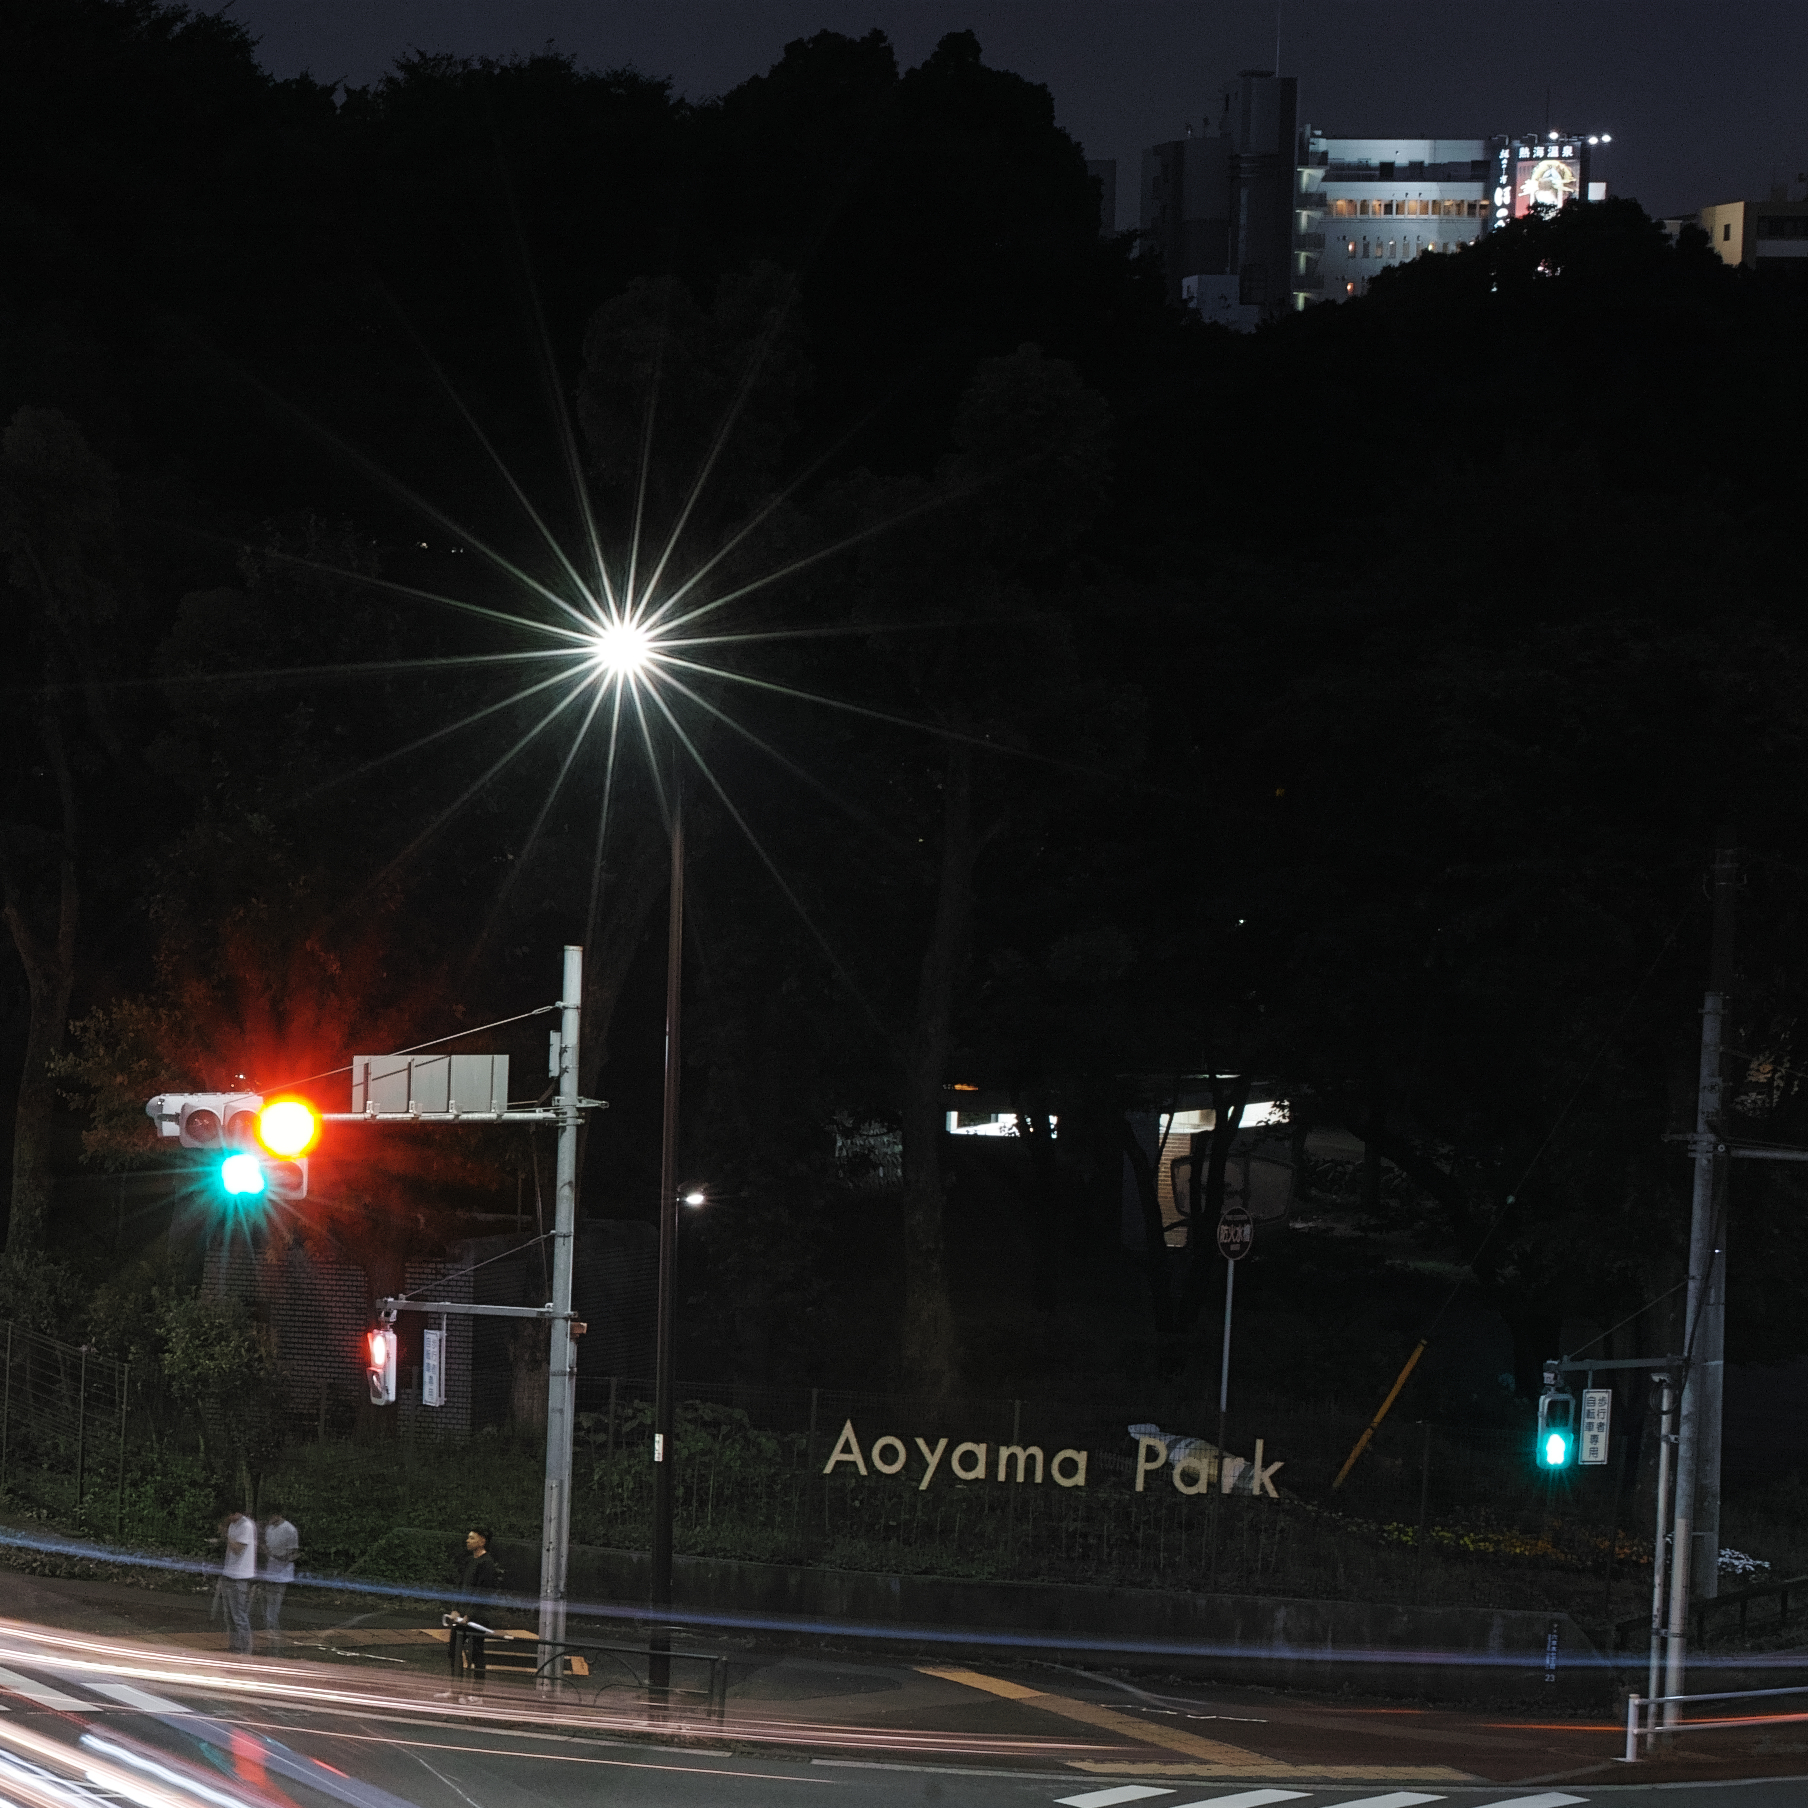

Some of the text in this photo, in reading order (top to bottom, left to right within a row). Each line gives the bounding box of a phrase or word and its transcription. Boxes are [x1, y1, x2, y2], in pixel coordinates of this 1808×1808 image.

[1518, 145, 1574, 159] 熱海温泉
[1585, 1397, 1596, 1432] 自転車
[1597, 1397, 1608, 1432] 歩行者
[822, 1418, 1285, 1499] Aoyama Park
